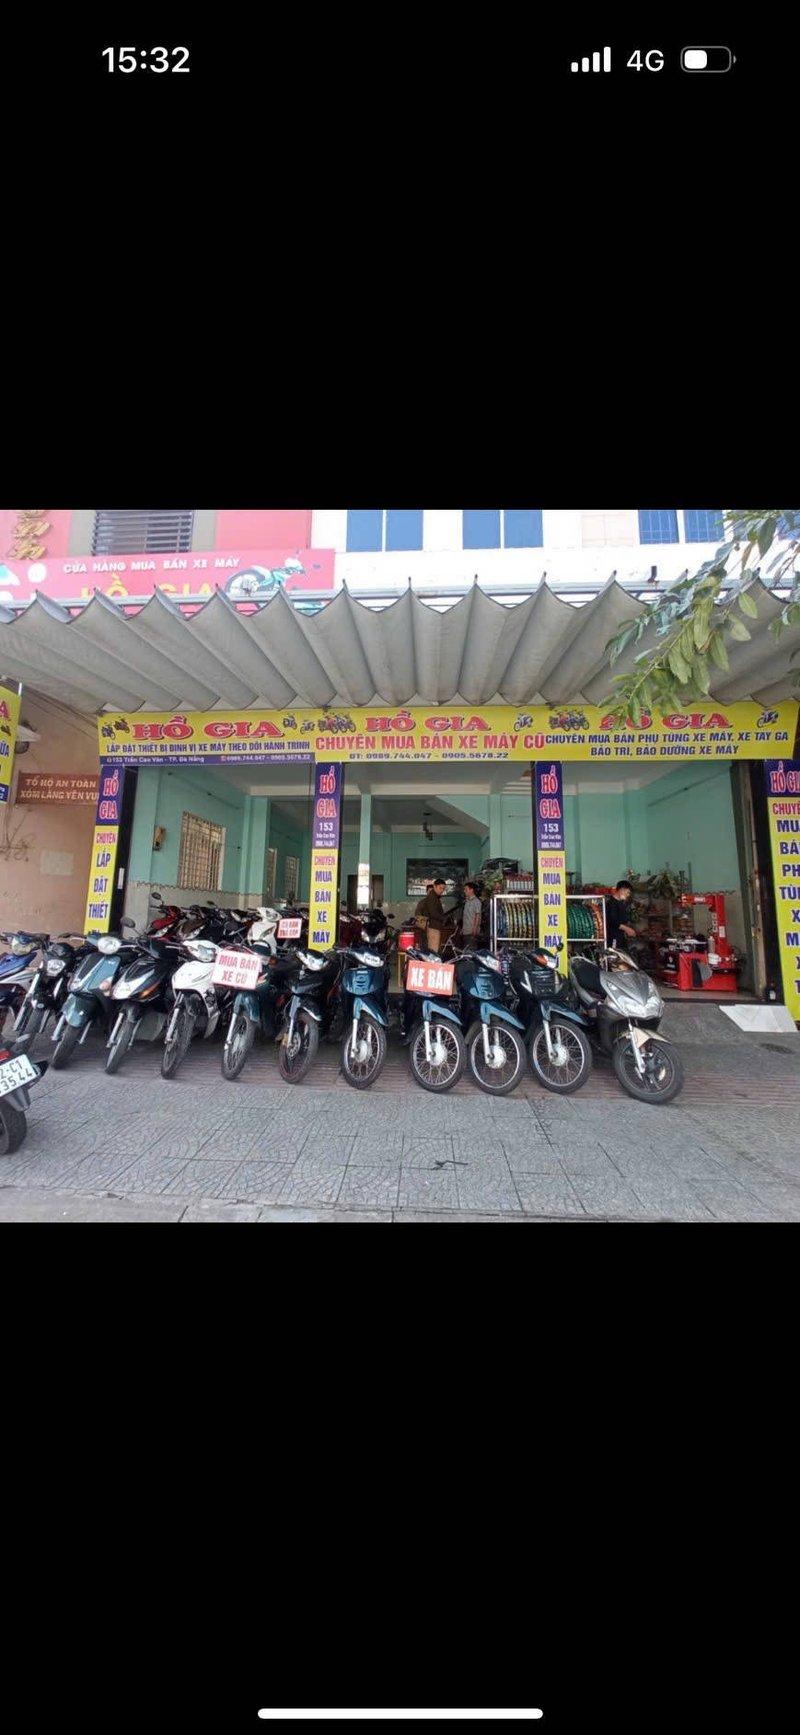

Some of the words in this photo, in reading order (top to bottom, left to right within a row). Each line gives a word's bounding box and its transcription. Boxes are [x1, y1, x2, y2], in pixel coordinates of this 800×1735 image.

[63, 562, 88, 574] CỬA
[93, 559, 127, 572] HÀNG
[131, 560, 157, 571] MUA
[163, 557, 188, 570] BÁN
[193, 559, 208, 568] XE
[214, 556, 240, 568] MÁY
[131, 713, 198, 741] HỒ
[203, 722, 284, 739] GIA
[365, 709, 417, 733] HỒ
[424, 715, 492, 732] GIA
[661, 713, 734, 730] GIA
[138, 741, 158, 752] THIẾT
[198, 743, 208, 752] XE
[210, 740, 226, 752] MÁY
[228, 741, 247, 751] THEO
[315, 733, 376, 750] CHUYÊN
[381, 735, 415, 749] MUA
[420, 732, 453, 749] BÁN
[458, 735, 478, 748] XE
[483, 732, 518, 749] MÁY
[523, 732, 545, 749] CŨ
[545, 732, 585, 744] CHUYÊN
[589, 734, 610, 743] MUA
[613, 732, 635, 743] BÁN
[639, 733, 659, 744] PHỤ
[662, 732, 689, 742] TÙNG
[693, 733, 706, 742] XE
[738, 732, 751, 741] XE
[755, 732, 771, 741] TAY
[774, 732, 788, 741] GA
[699, 746, 712, 754] XE
[716, 743, 739, 754] MÁY
[103, 769, 120, 797] HỒ
[318, 765, 337, 794] HỒ
[540, 765, 559, 794] HỒ
[98, 800, 118, 820] GIA
[316, 798, 337, 818] GIA
[540, 798, 562, 819] GIA
[319, 822, 333, 831] 153
[543, 823, 559, 832] 153
[315, 871, 333, 882] MUA
[542, 873, 561, 884] MUA
[315, 887, 332, 903] BÁN
[543, 890, 561, 905] BÁN
[316, 911, 328, 922] XE
[547, 914, 559, 927] XE
[312, 929, 331, 943] MÁY
[218, 955, 238, 968] MUA
[239, 957, 258, 971] BÁN
[223, 971, 233, 982] XE
[410, 967, 425, 987] XE
[428, 967, 452, 990] BÁN
[0, 1068, 33, 1094] 3544
